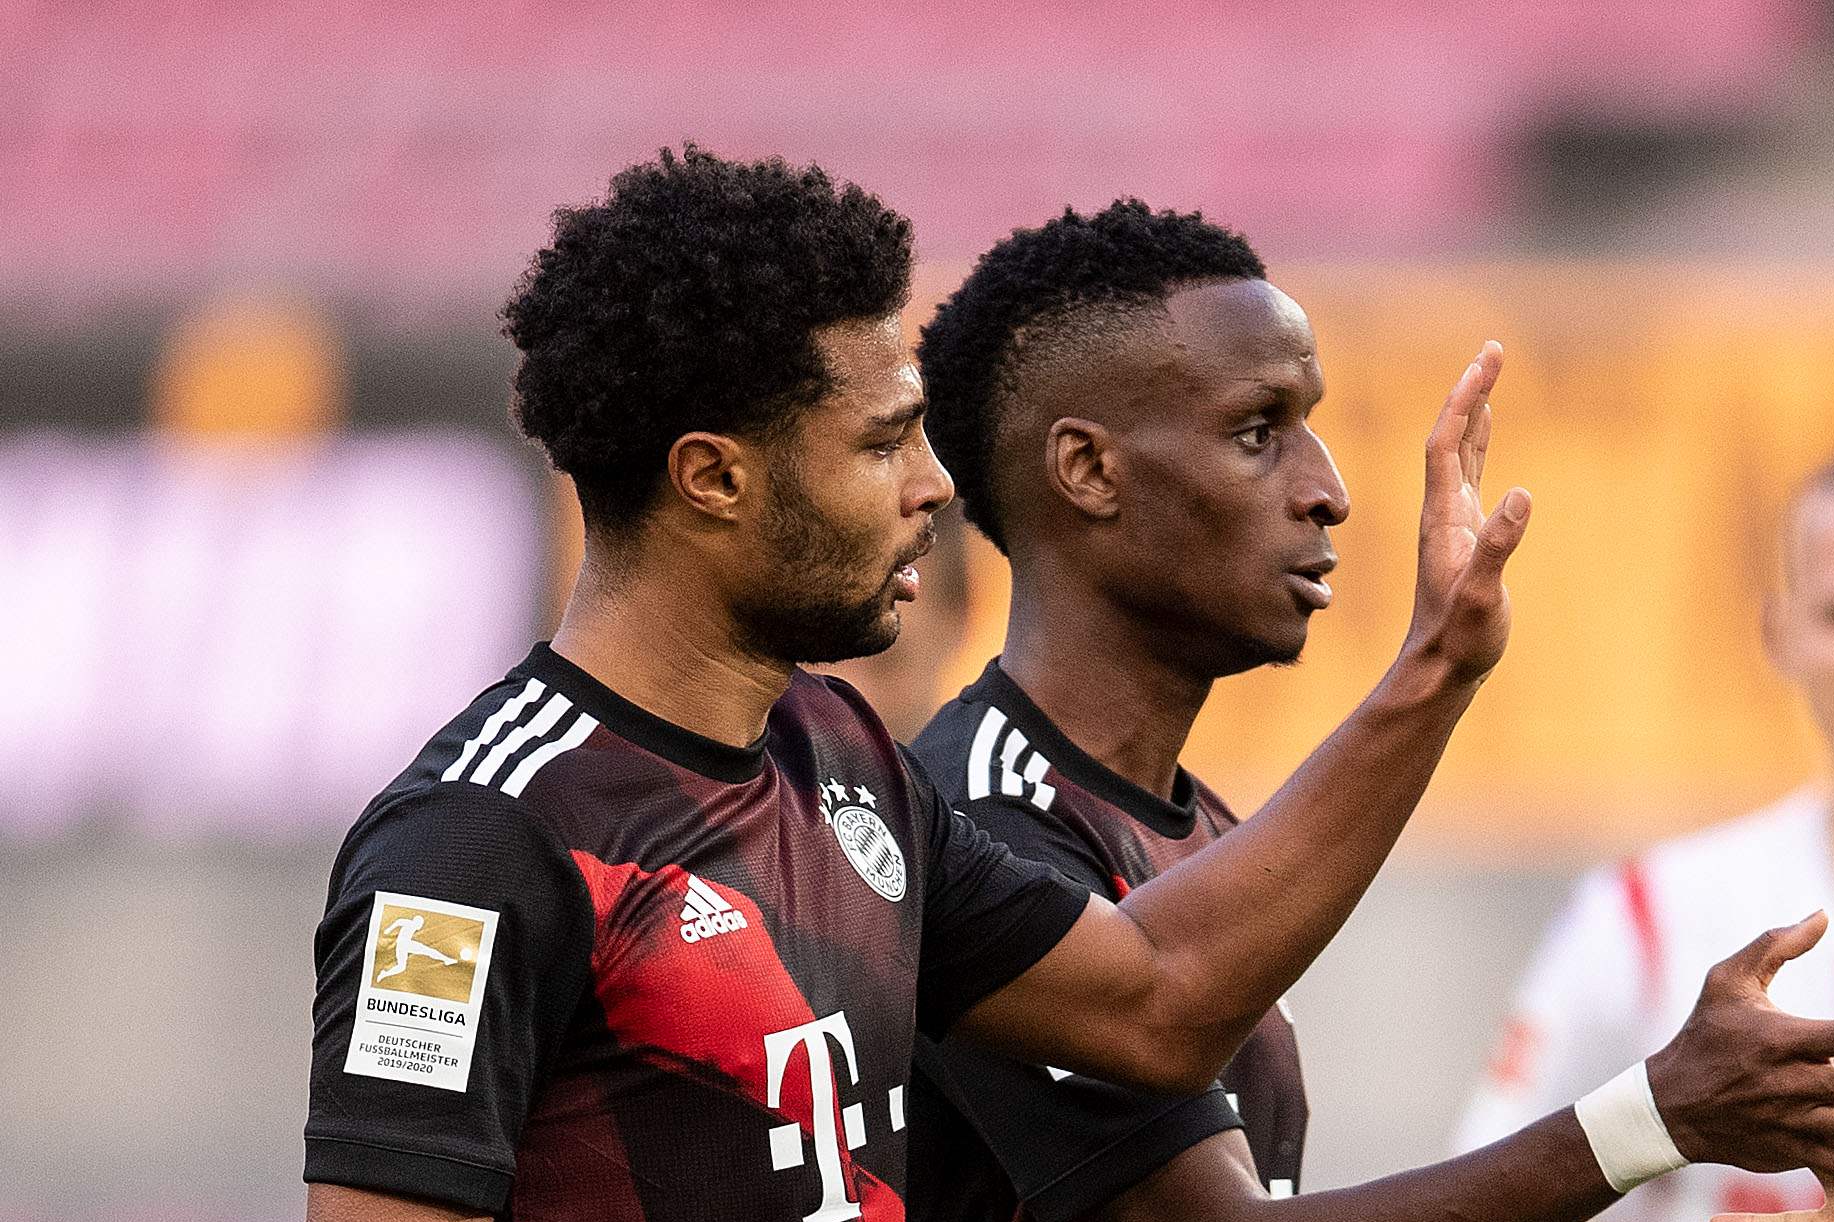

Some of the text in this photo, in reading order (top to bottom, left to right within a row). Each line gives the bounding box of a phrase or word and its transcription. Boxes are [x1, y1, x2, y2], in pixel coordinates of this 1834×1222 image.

[842, 812, 887, 837] BAYERN
[680, 909, 748, 944] adidas
[367, 998, 466, 1026] BUNDESLIGA
[359, 1042, 459, 1067] FUSSBALLMEISTER
[378, 1034, 442, 1053] DEUTSCHER
[377, 1056, 434, 1074] 2019/2020
